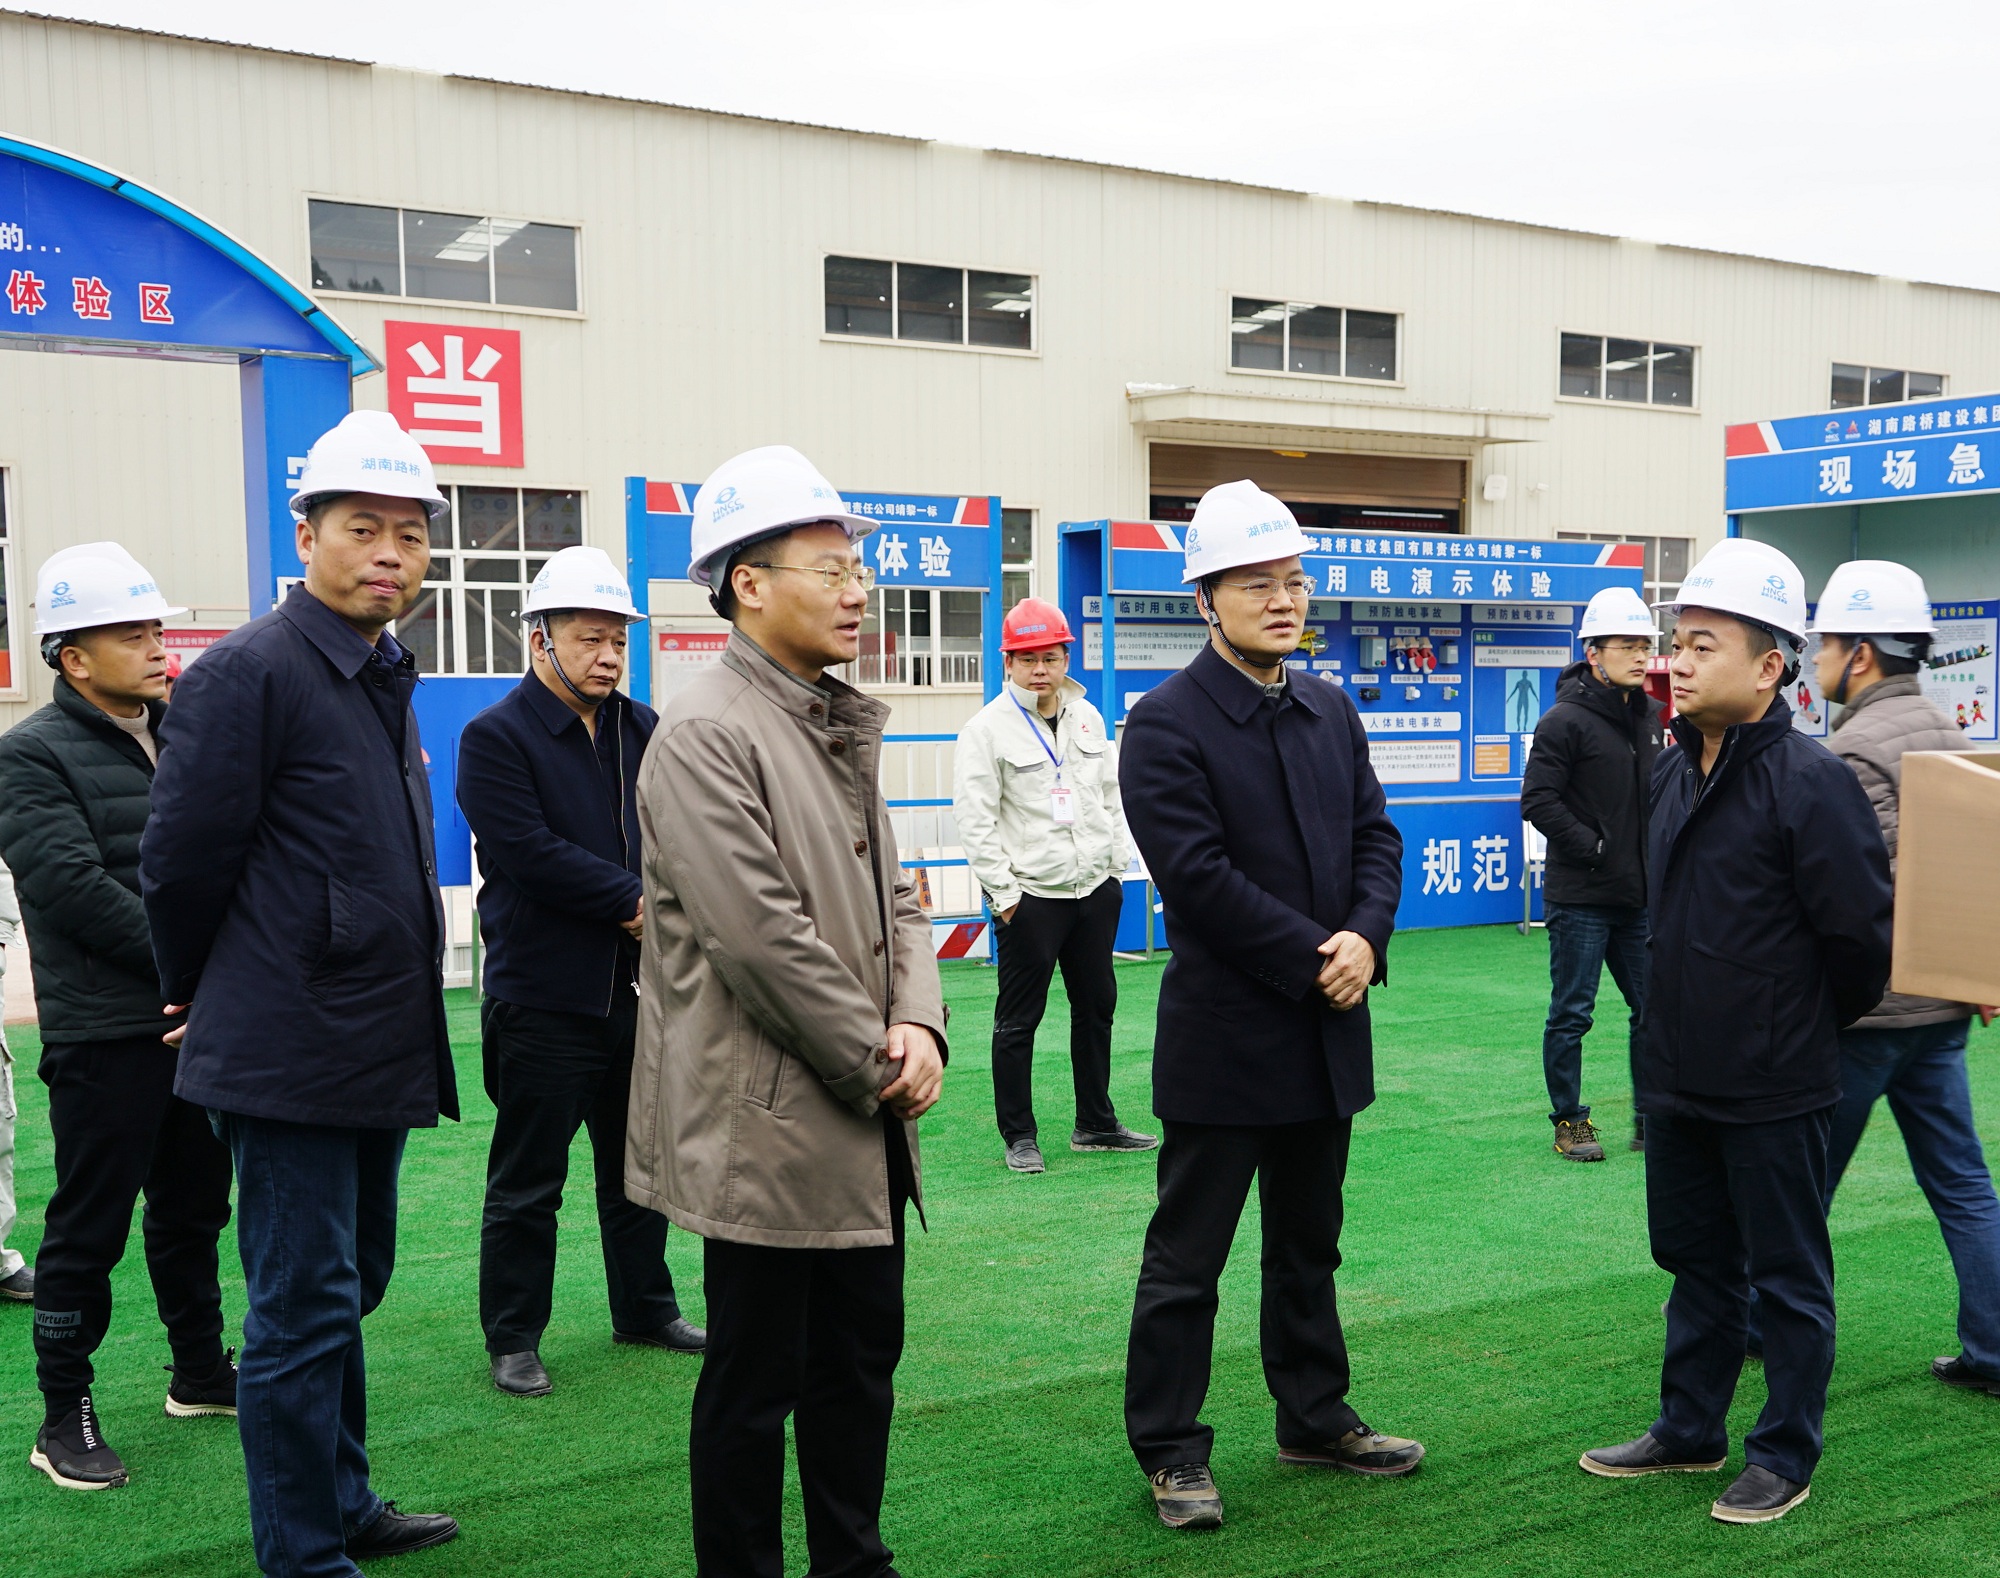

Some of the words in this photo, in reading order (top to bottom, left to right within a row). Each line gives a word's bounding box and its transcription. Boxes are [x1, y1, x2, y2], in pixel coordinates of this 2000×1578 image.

[5, 268, 175, 325] 体验区
[406, 334, 503, 455] 当
[360, 457, 421, 478] 湖南路桥
[1818, 442, 1986, 496] 现场急
[713, 498, 742, 519] HNCC
[853, 533, 952, 577] 体验
[1326, 564, 1552, 598] 用电演示体验
[1762, 586, 1788, 600] HNCC
[1368, 605, 1442, 620] 预防触电事故
[1487, 608, 1556, 621] 预防触电事故
[1370, 717, 1443, 729] 人体触电事故
[36, 1312, 76, 1325] Virtual
[38, 1327, 77, 1339] Nature
[81, 1396, 97, 1450] CHARRIOL
